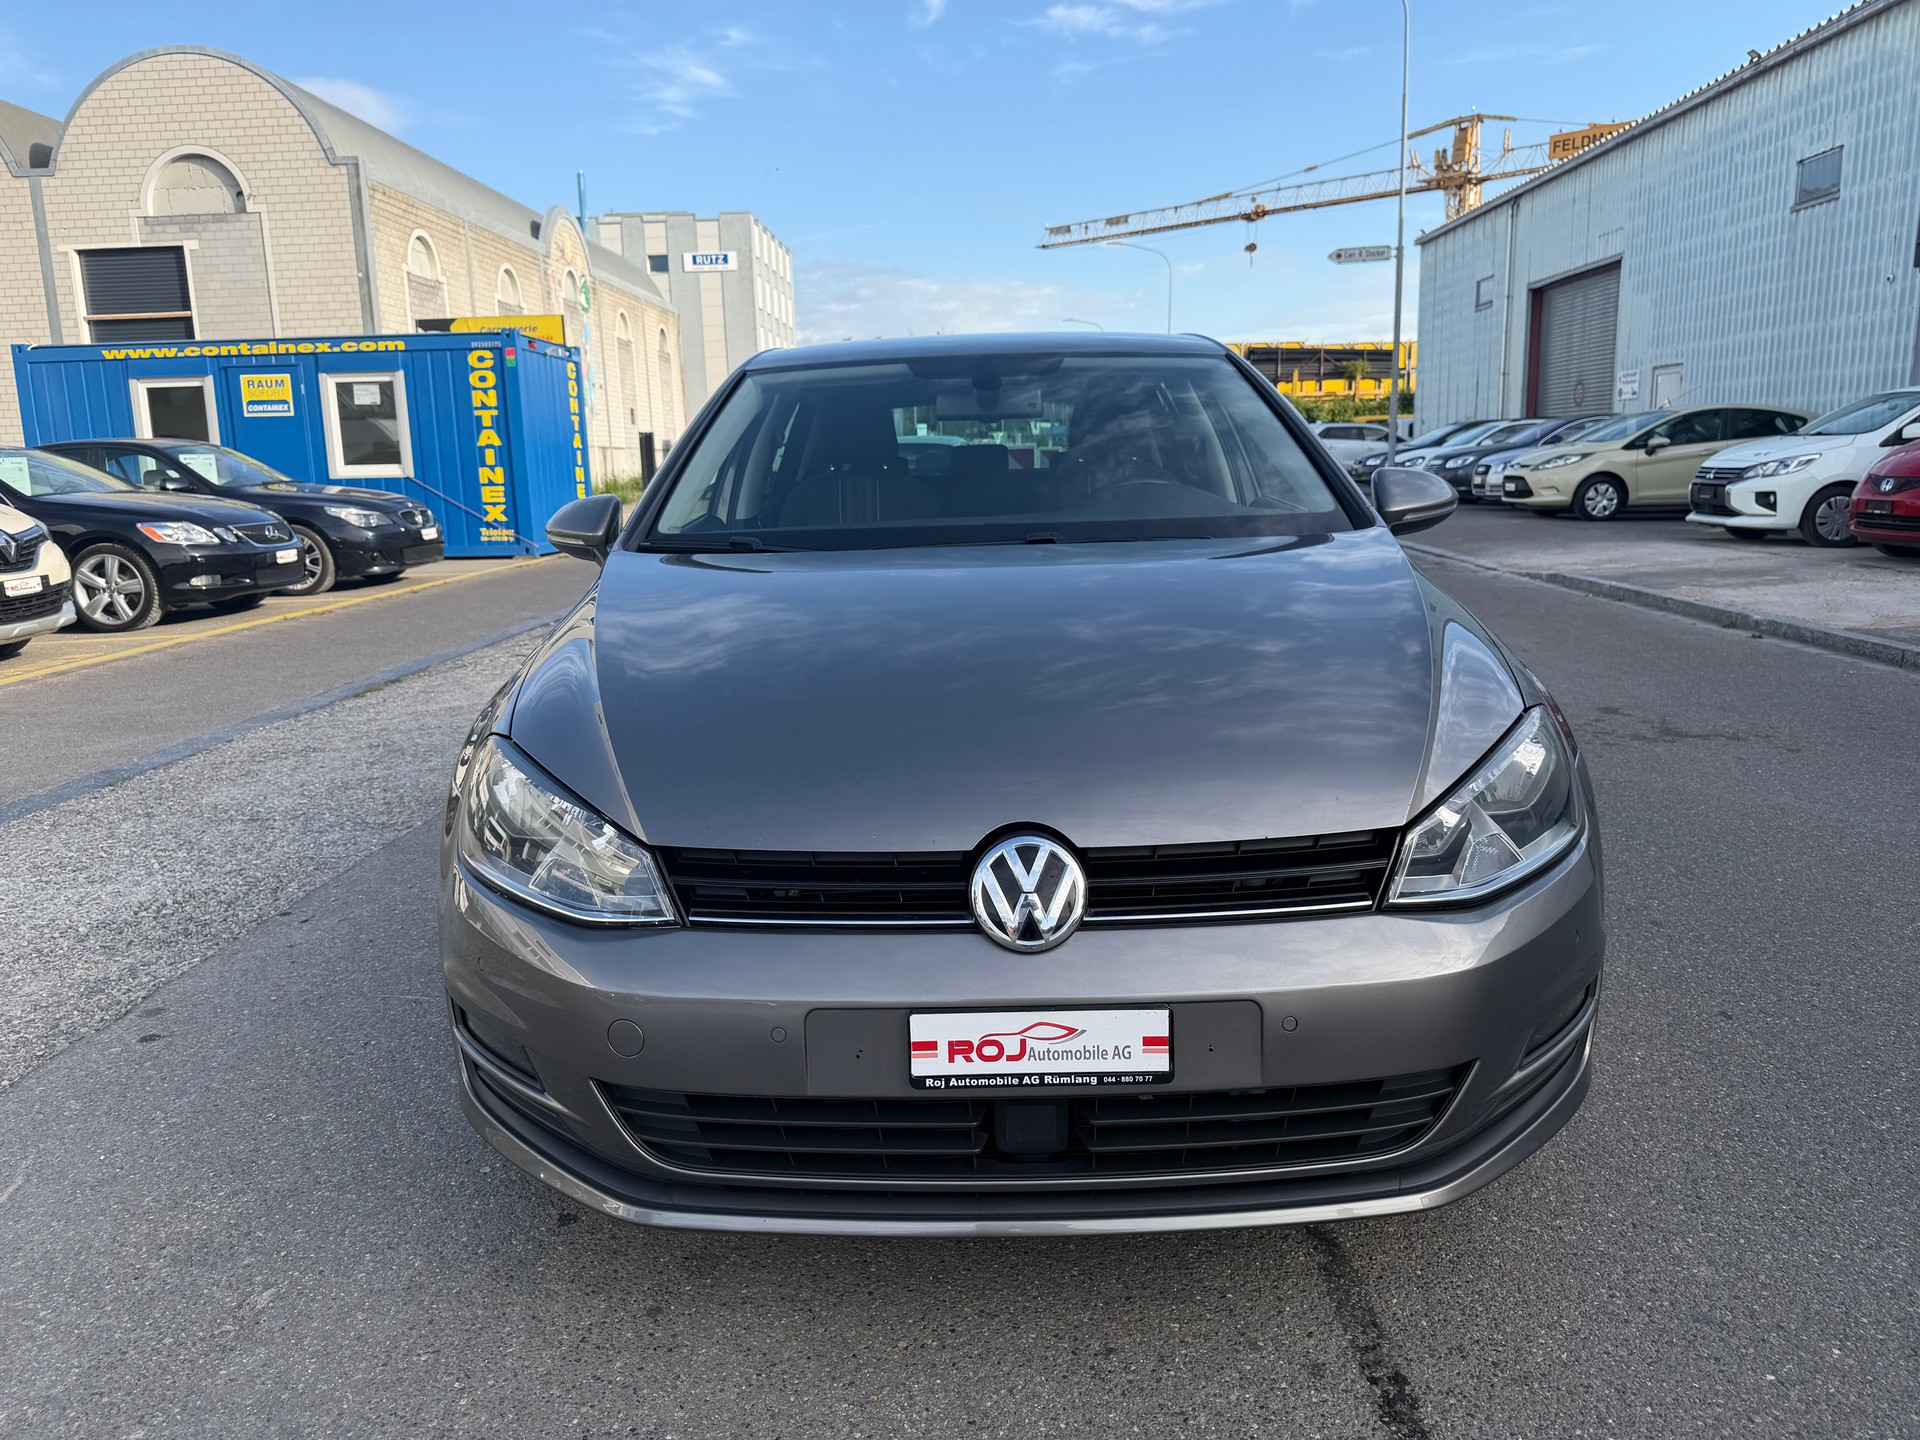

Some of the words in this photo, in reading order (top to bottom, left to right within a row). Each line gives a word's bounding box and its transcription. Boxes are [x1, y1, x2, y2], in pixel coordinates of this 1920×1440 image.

[695, 254, 725, 265] RUTZ
[480, 325, 538, 334] Carrerie
[101, 339, 406, 361] www.containex.com
[247, 379, 285, 389] RAUM
[248, 388, 285, 398] SOFORT
[248, 403, 289, 413] CONTAINEX
[467, 350, 508, 522] CONTAINEX
[567, 362, 586, 499] CONTAINE
[970, 835, 1087, 953] VW
[948, 1039, 1027, 1064] ROJ
[1028, 1045, 1109, 1062] Automobile
[1112, 1045, 1132, 1061] AG
[925, 1078, 946, 1089] Roj
[949, 1076, 1019, 1087] Automobile
[1022, 1075, 1040, 1085] AG
[1044, 1074, 1098, 1086] Rümlang
[1103, 1076, 1116, 1084] 044
[1121, 1075, 1134, 1083] 880
[1135, 1075, 1144, 1083] 70
[1145, 1075, 1153, 1083] 77
